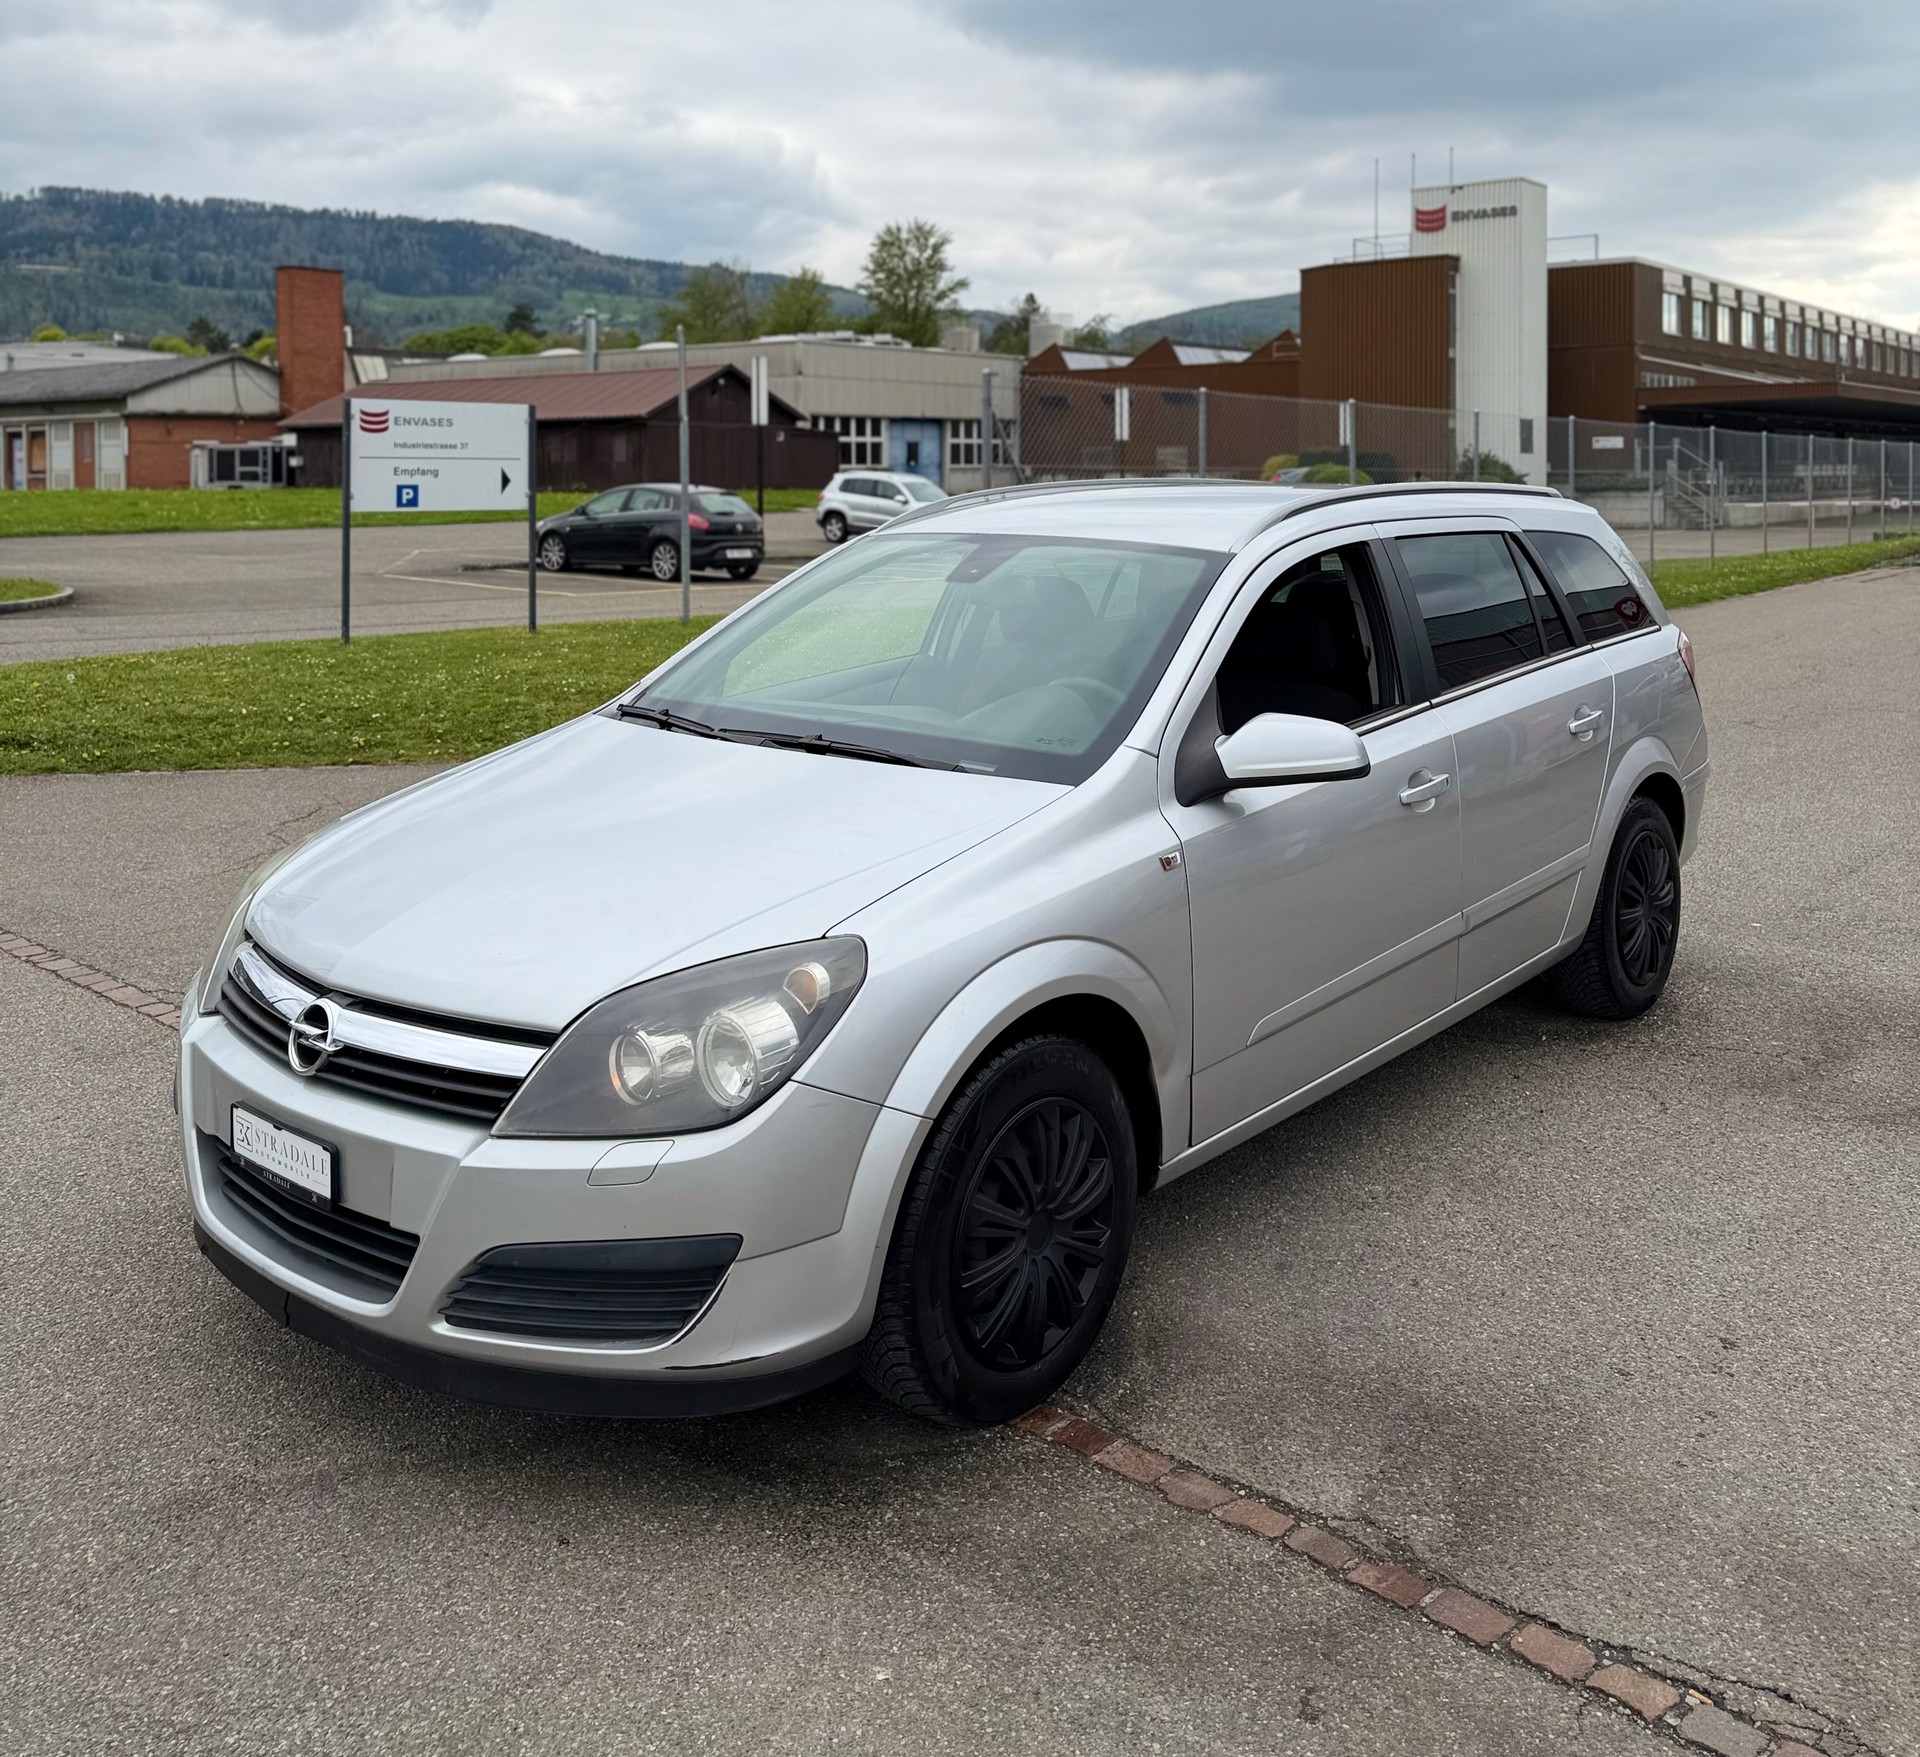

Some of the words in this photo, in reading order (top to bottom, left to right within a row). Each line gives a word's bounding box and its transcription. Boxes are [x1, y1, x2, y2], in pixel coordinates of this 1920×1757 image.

[393, 416, 454, 427] ENVASES
[393, 441, 458, 450] Industriestrasse
[459, 442, 469, 450] 37
[393, 467, 439, 478] Empfang
[255, 1128, 328, 1176] STRADALE
